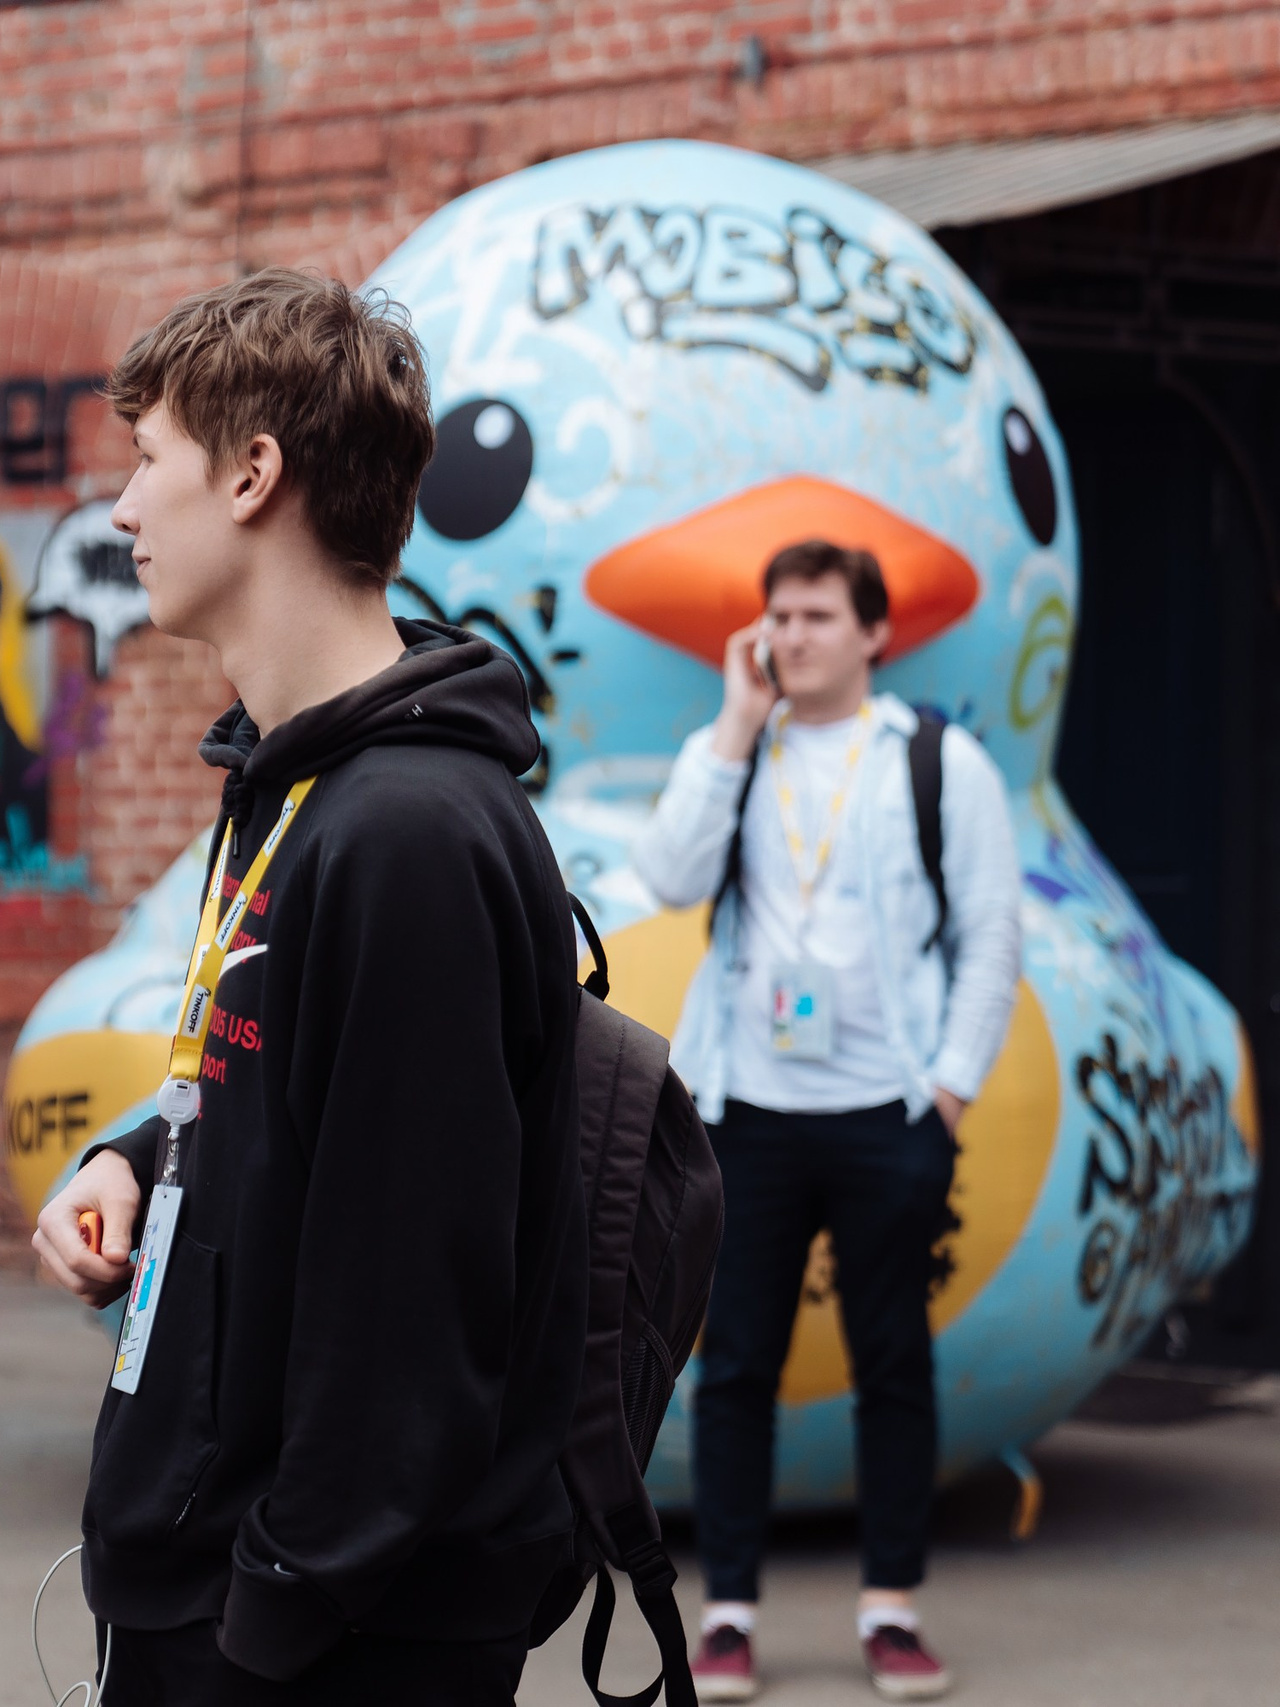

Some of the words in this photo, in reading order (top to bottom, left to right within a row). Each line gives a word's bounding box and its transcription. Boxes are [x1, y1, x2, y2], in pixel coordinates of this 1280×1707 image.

[220, 901, 243, 943] TINKOFF
[188, 992, 204, 1033] TINKOFF
[227, 1013, 262, 1051] US
[202, 1053, 227, 1085] port
